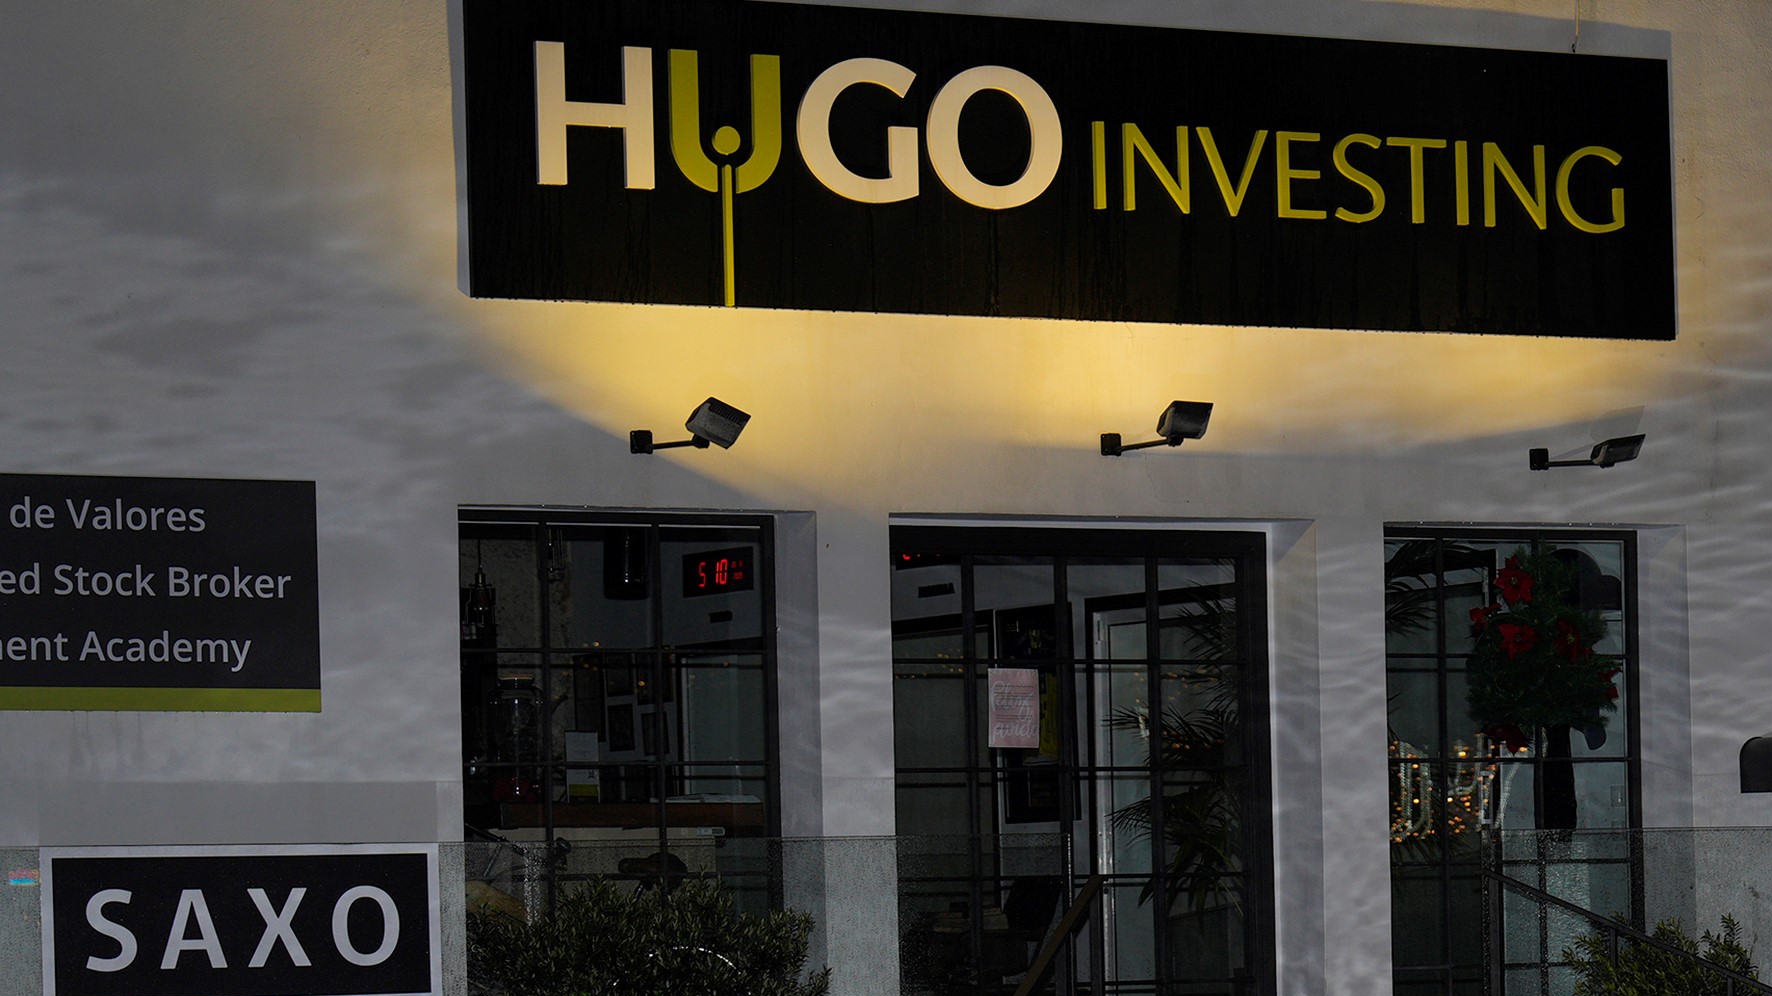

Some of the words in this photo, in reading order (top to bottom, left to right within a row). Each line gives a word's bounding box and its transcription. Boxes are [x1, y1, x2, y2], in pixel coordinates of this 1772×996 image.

[533, 40, 1063, 307] HUGO
[1092, 119, 1626, 234] INVESTING
[9, 496, 55, 529] de
[65, 497, 206, 532] Valores
[53, 563, 156, 596] Stock
[168, 566, 292, 599] Broker
[79, 630, 252, 672] Academy
[84, 884, 402, 974] SAXO
